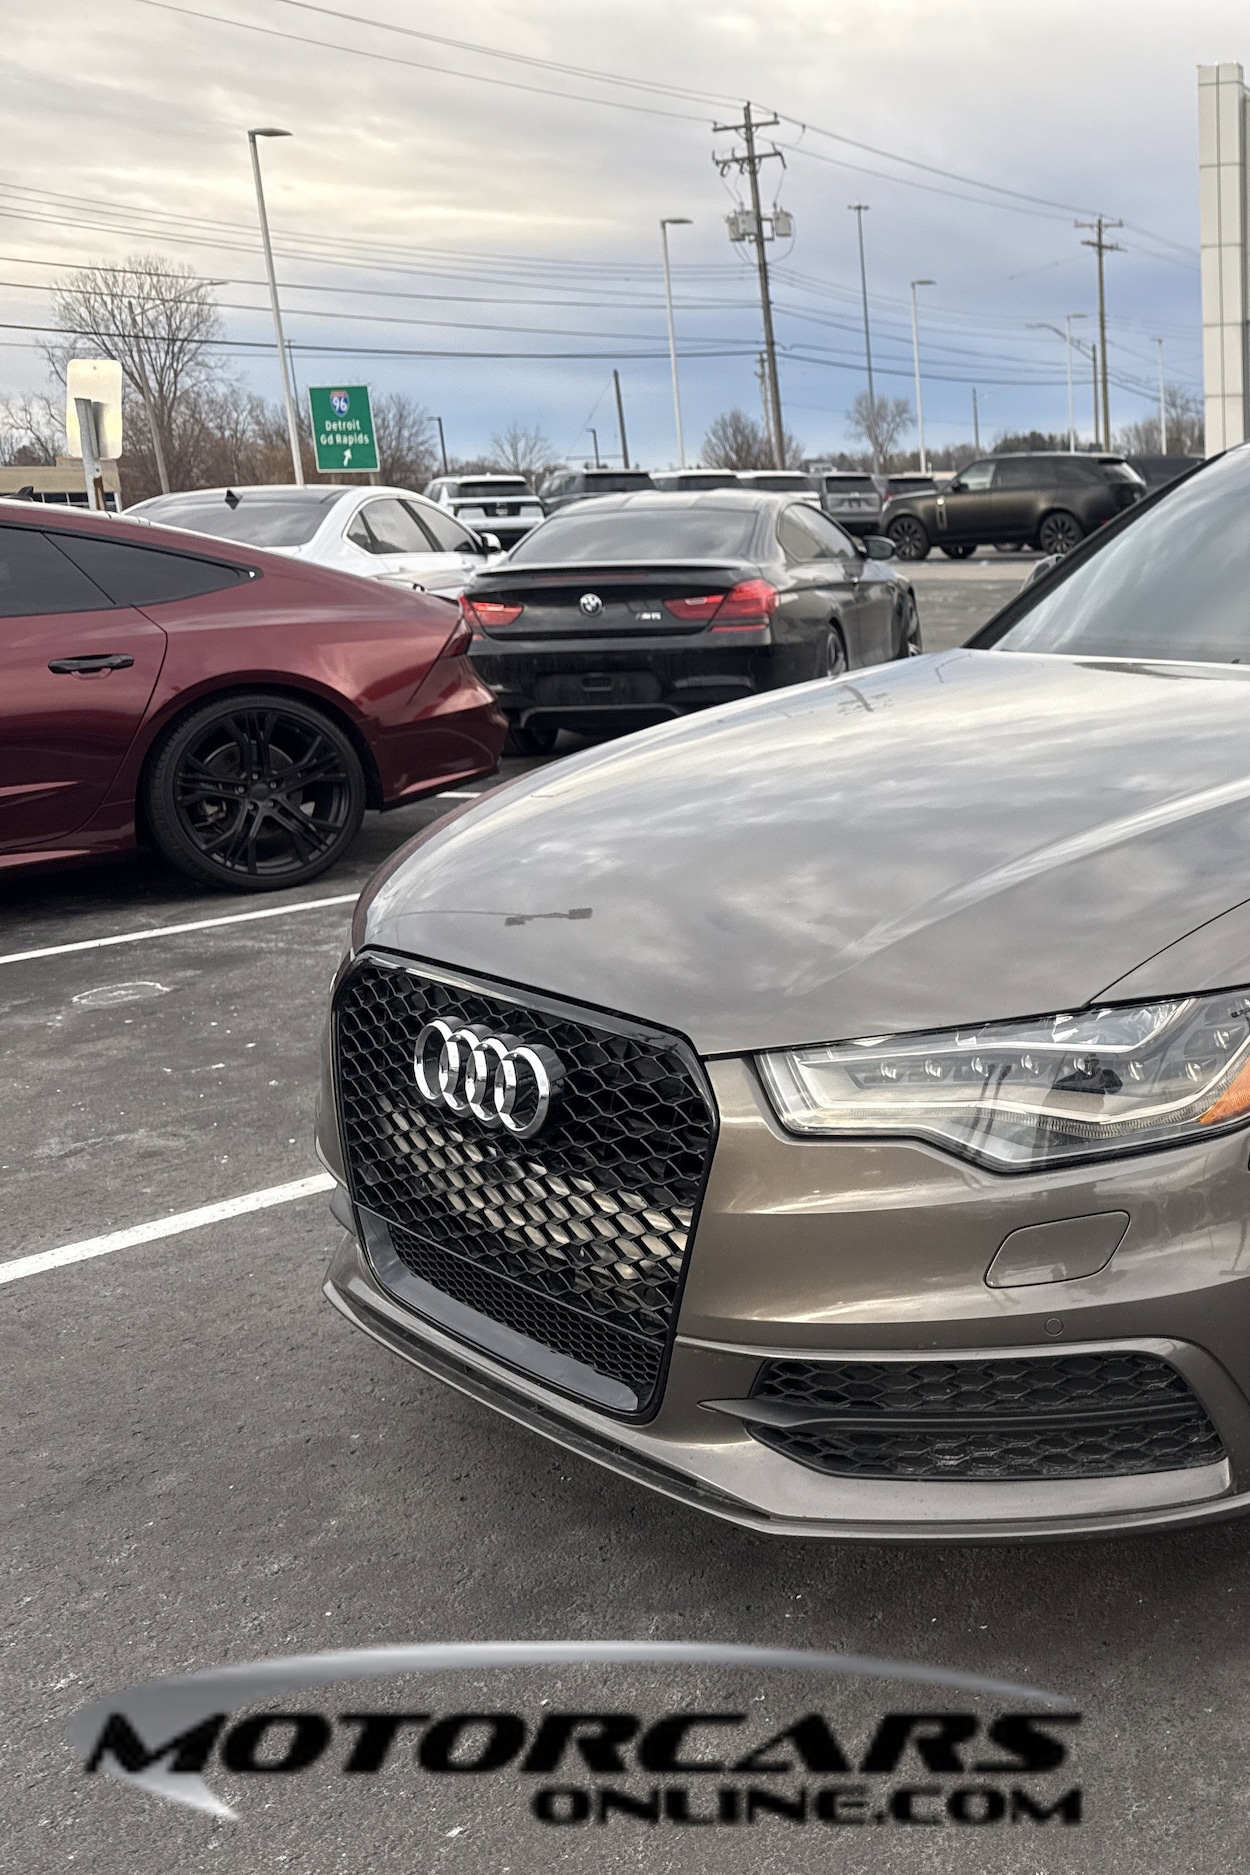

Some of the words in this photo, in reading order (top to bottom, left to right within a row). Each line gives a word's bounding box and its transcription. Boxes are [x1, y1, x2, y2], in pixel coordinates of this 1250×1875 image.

[332, 396, 348, 411] 96
[325, 419, 361, 432] Detroit
[320, 433, 334, 446] Gd
[336, 432, 370, 447] Rapids
